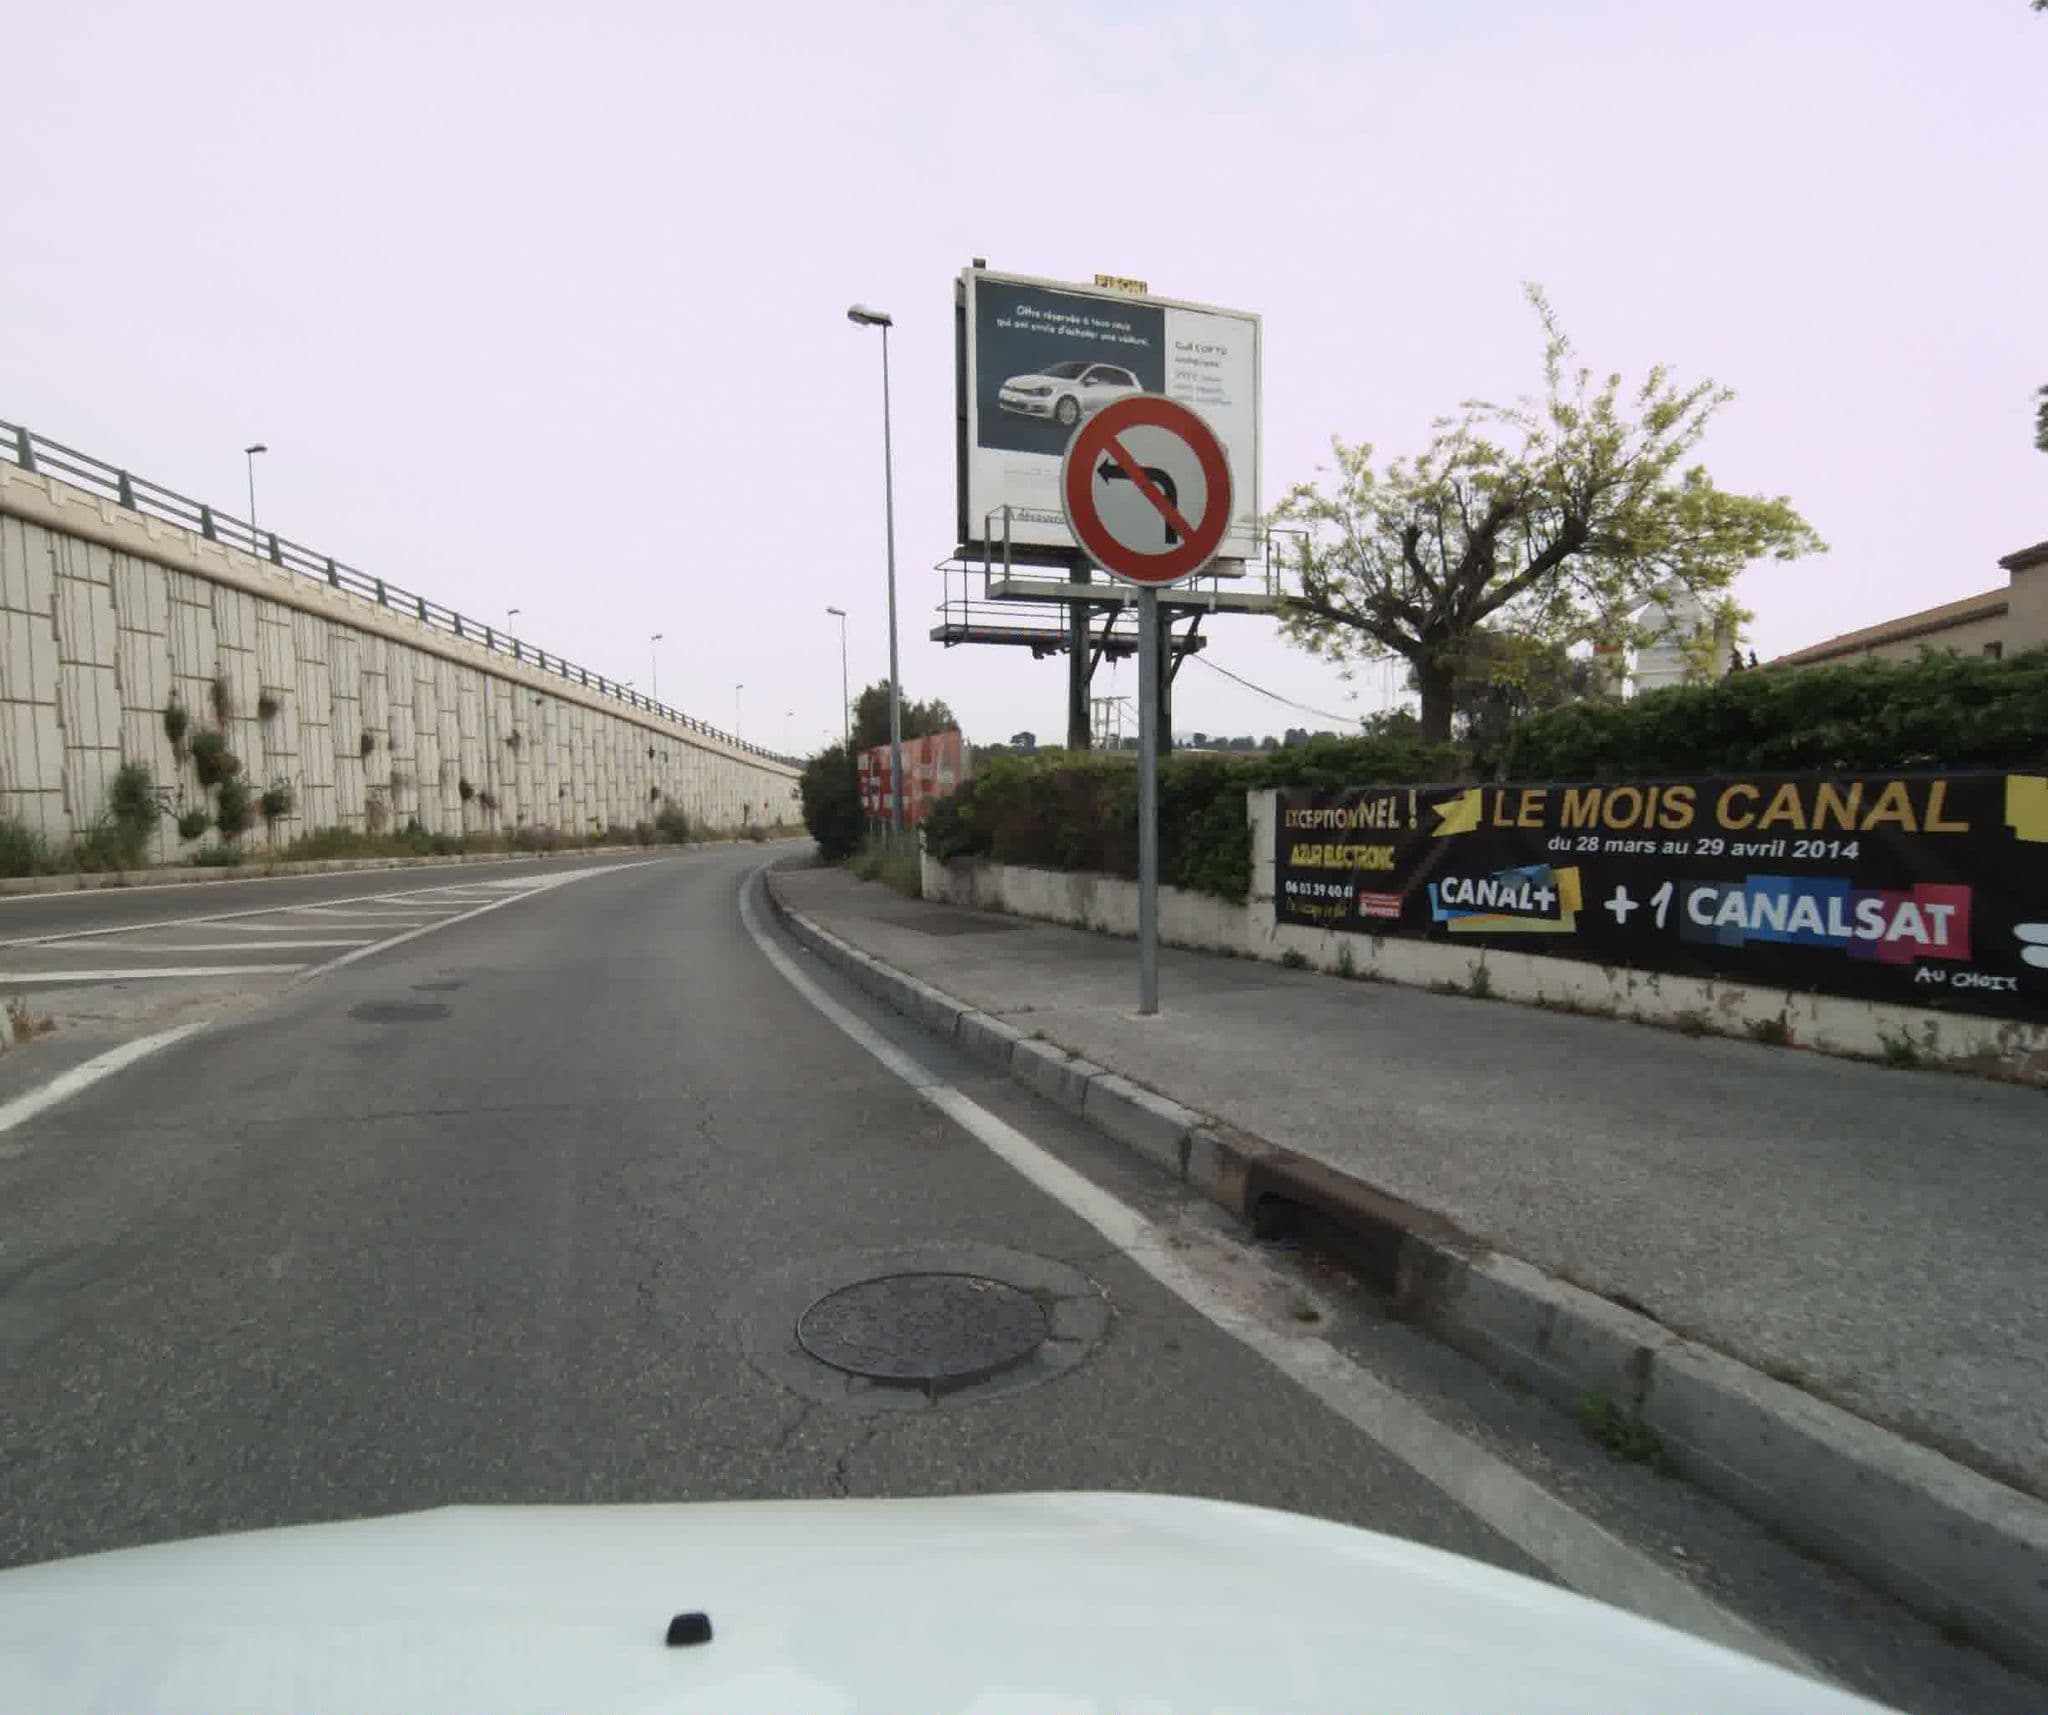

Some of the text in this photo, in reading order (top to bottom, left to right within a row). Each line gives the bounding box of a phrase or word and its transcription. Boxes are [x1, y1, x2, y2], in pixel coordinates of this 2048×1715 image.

[1285, 796, 1400, 830] EXCEPTIONNEL
[1492, 780, 1969, 833] LE MOIS CANAL
[1548, 836, 1860, 860] du 28 mars au 29 avril 2014
[1441, 876, 1556, 912] CANAL+
[1687, 887, 1956, 946] CANALSAT
